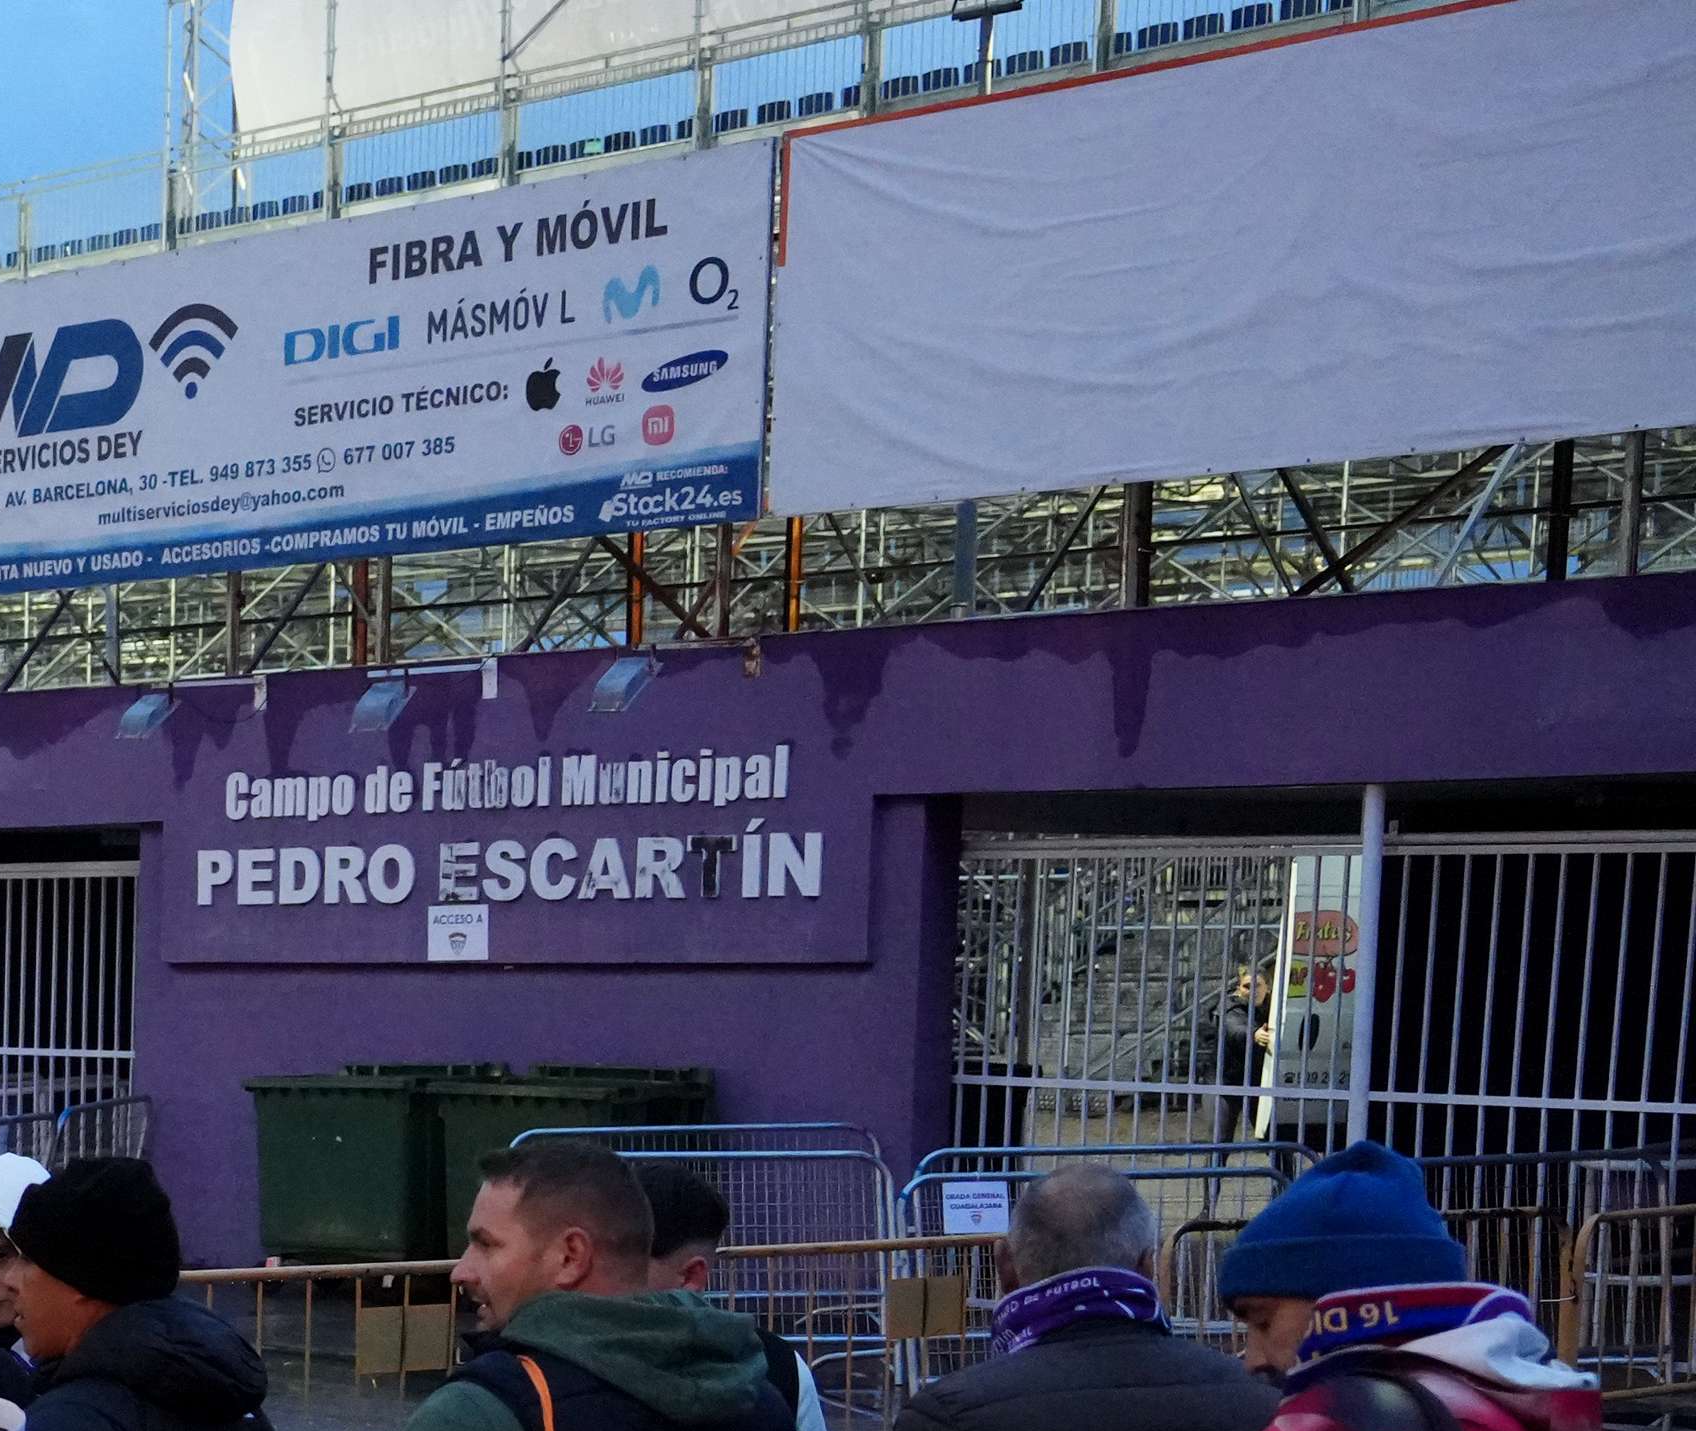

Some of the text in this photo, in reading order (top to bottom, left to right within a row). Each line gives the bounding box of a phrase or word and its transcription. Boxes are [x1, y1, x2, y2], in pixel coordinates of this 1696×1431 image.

[369, 198, 668, 285] FIBRA Y MÓVIL
[427, 288, 575, 345] MÁSMÓVL
[284, 315, 400, 366] DIGI
[652, 360, 719, 382] SAMSUNG
[294, 383, 509, 428] SERVICIO TÉCNICO:
[585, 394, 626, 407] HUAWEI
[98, 430, 143, 461] DEY
[588, 424, 617, 448] LG
[5, 489, 28, 508] AV.
[33, 478, 134, 504] BARCELONA,
[139, 473, 158, 491] 30
[210, 463, 239, 482] 949
[245, 458, 277, 479] 873
[281, 453, 312, 474] 355
[344, 446, 376, 466] 677
[382, 441, 415, 462] 007
[422, 436, 455, 457] 385
[612, 484, 743, 517] Stock24.es
[23, 557, 72, 578] NUEVO
[77, 557, 87, 572] Y
[92, 552, 143, 571] USADO
[162, 538, 260, 564] ACCESORIOS
[385, 523, 406, 540] TU
[412, 514, 468, 538] MÓVIL
[485, 505, 575, 531] EMPEÑOS
[225, 744, 792, 823] Campo de Fútbol Municipal
[196, 818, 824, 908] PEDRO ESCARTÍN
[433, 913, 474, 925] ACCESO
[1313, 1300, 1400, 1336] 16 DI
